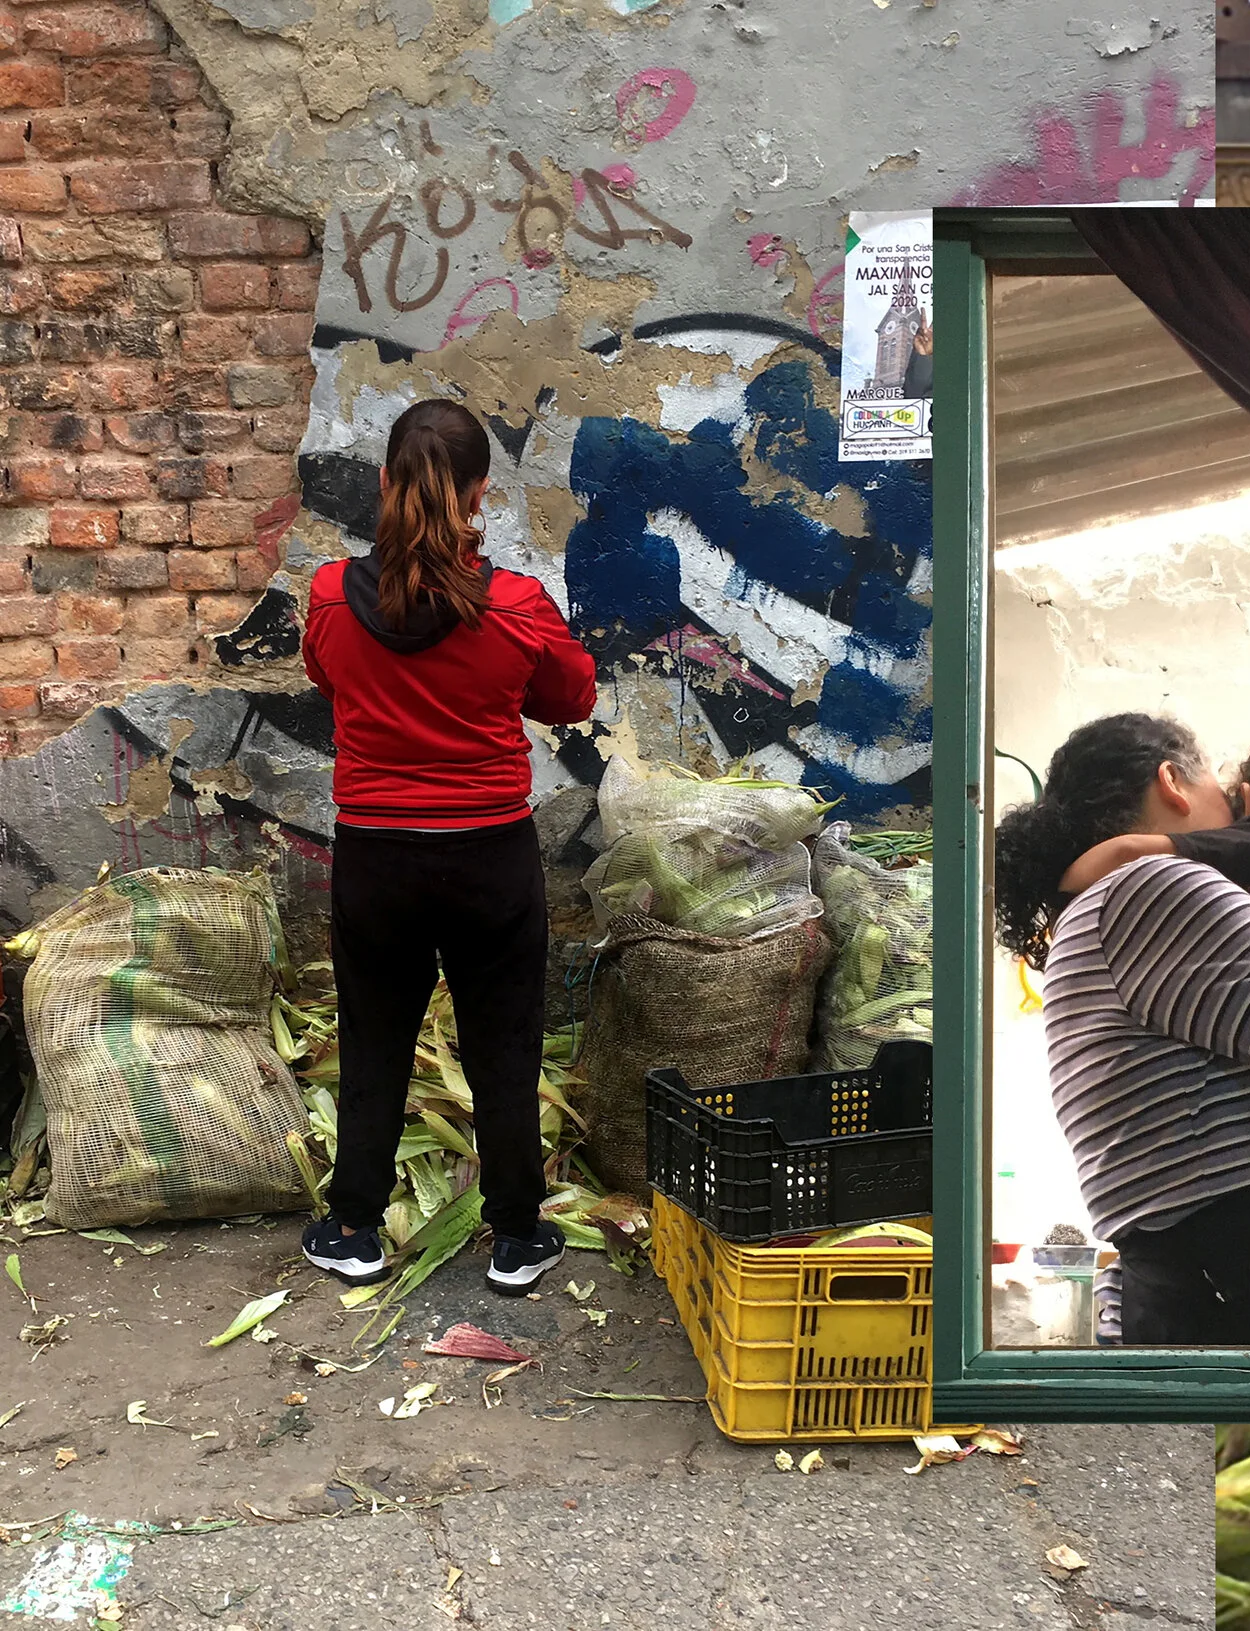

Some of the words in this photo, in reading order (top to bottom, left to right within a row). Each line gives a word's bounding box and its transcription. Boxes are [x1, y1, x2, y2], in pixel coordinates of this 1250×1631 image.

[862, 245, 875, 254] Por
[877, 245, 893, 253] una
[895, 244, 911, 253] San
[875, 253, 931, 264] transparencia
[856, 265, 933, 280] MAXIMINO
[868, 284, 888, 296] JAL
[892, 283, 916, 295] SAN
[891, 295, 918, 308] 2020
